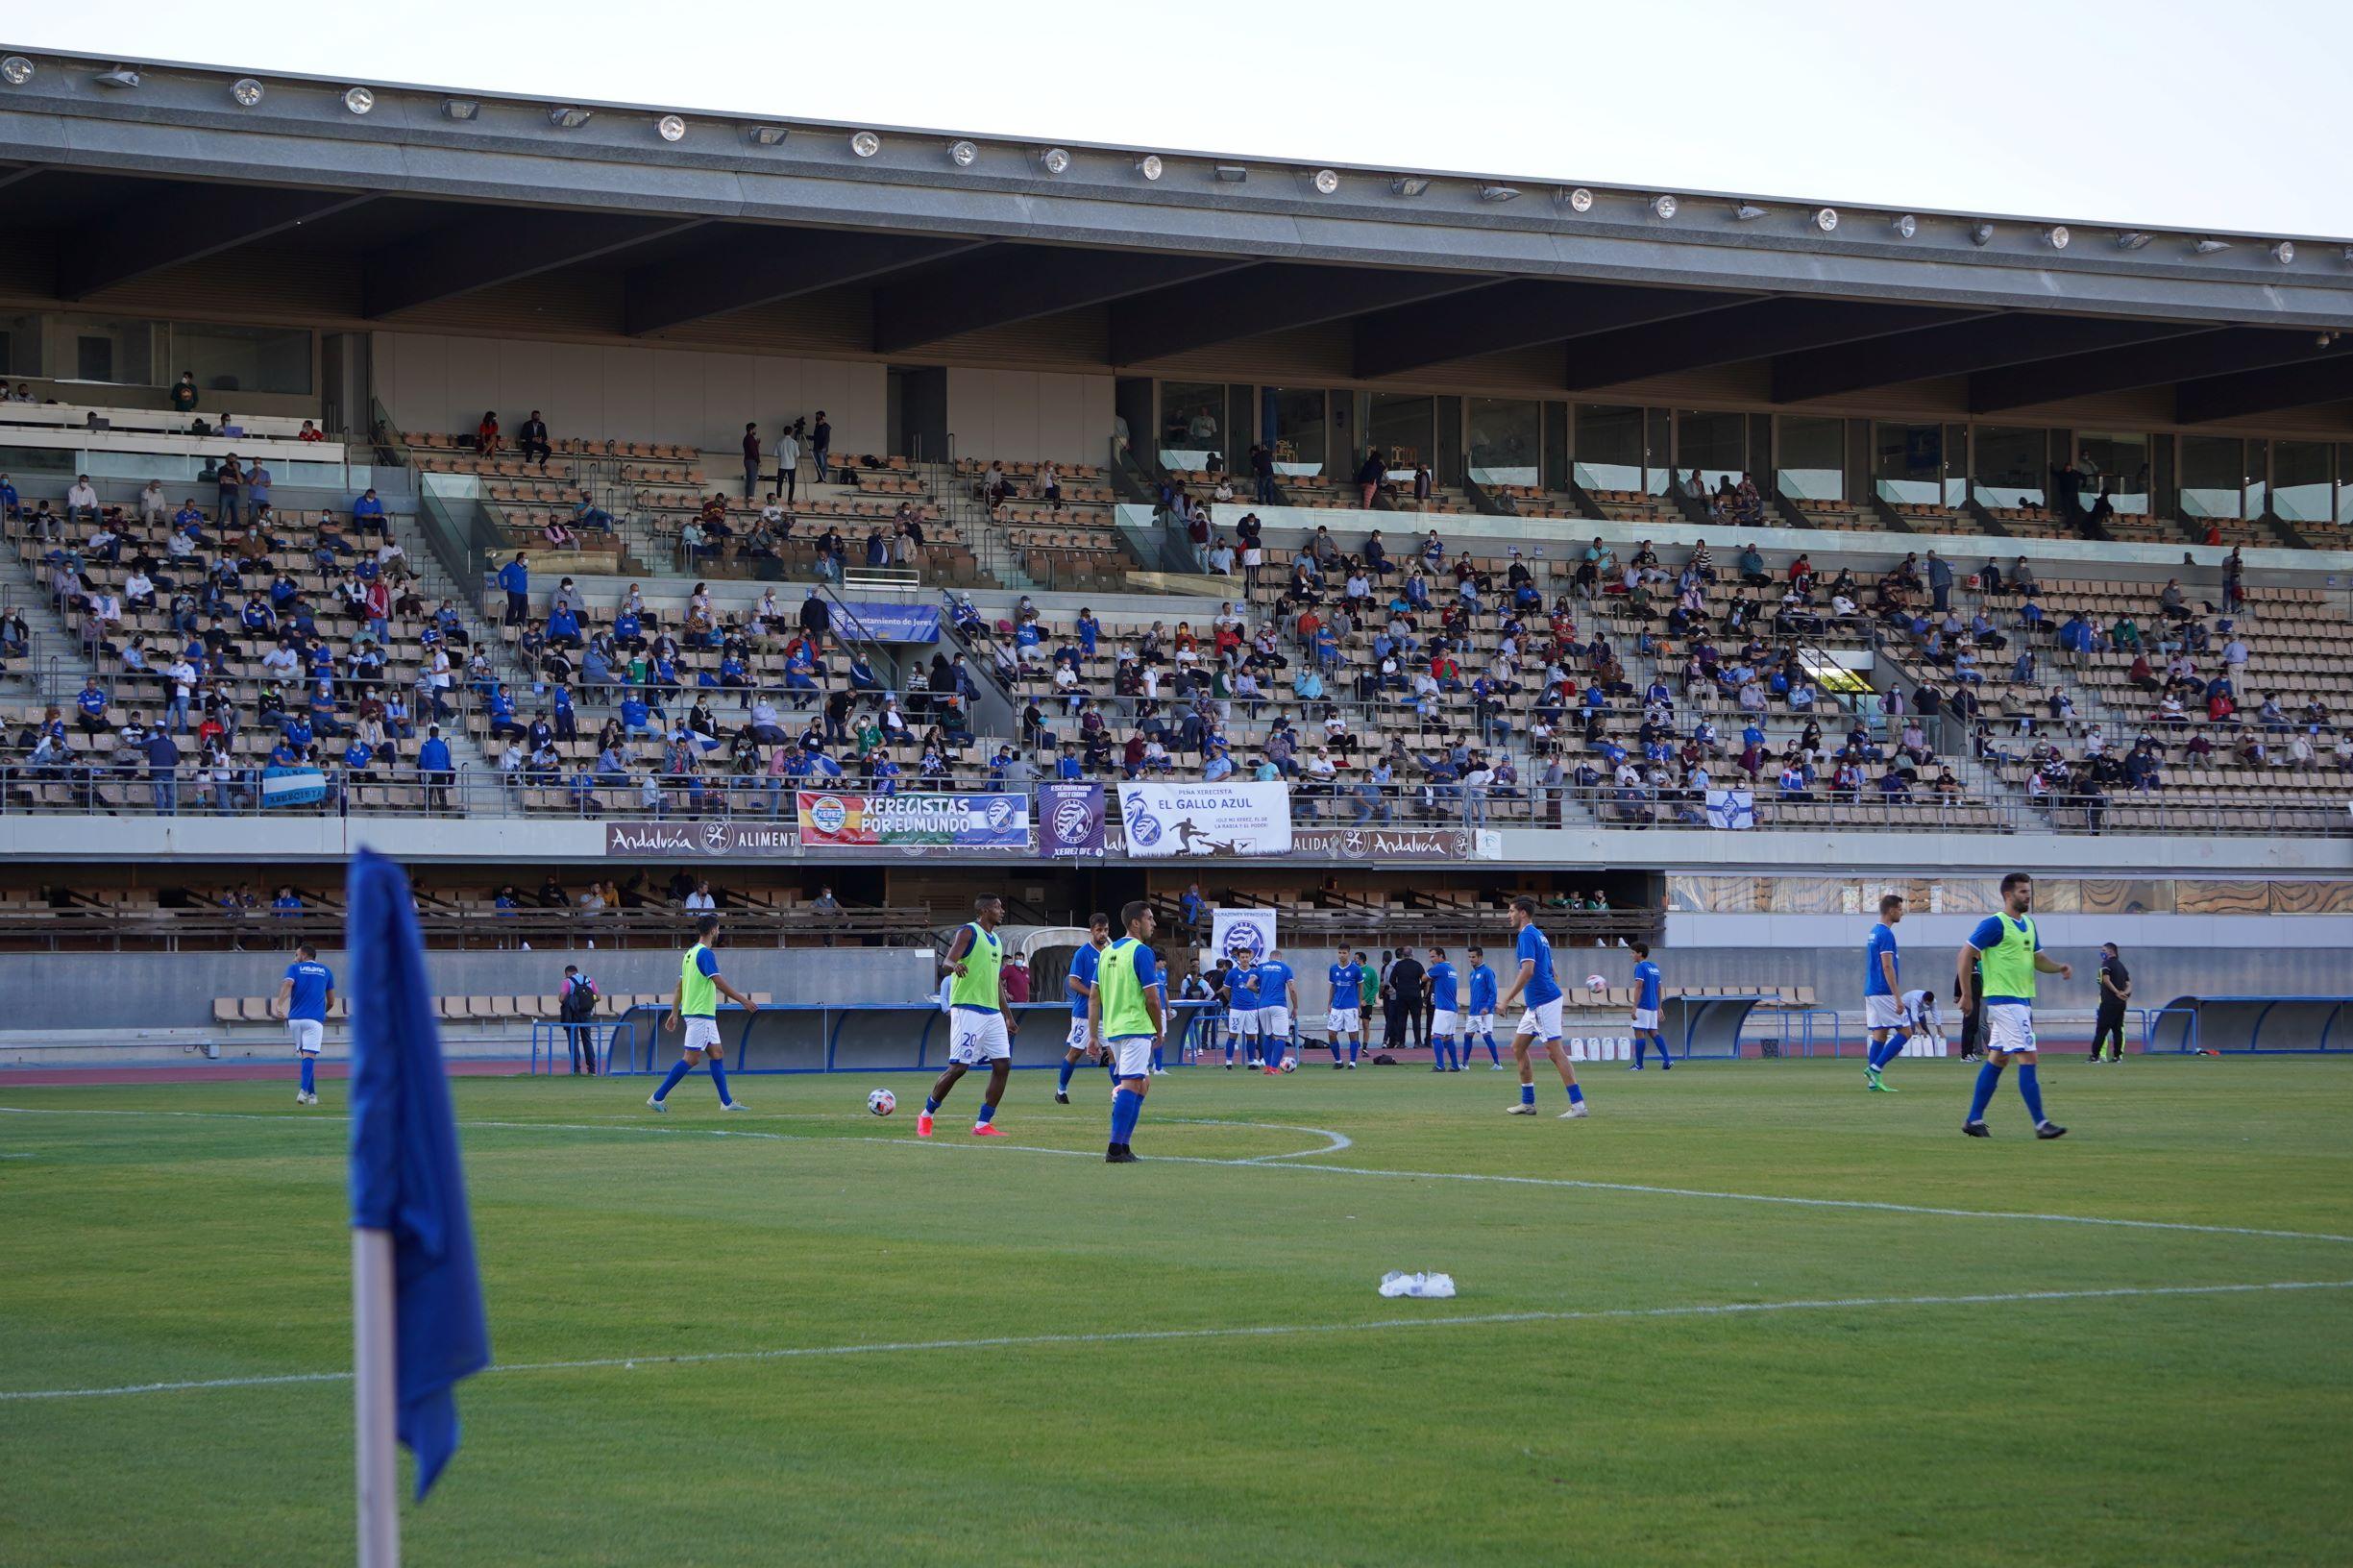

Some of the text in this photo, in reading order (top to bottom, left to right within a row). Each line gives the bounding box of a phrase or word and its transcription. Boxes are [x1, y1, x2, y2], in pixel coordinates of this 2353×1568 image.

[913, 618, 932, 626] Jerez
[1159, 797, 1253, 810] EL GALLO AZUL
[817, 810, 842, 819] XEREZ
[861, 818, 969, 833] POR EL MUNDO
[612, 827, 696, 850] Andalucía
[1293, 837, 1338, 850] ALIDA
[1374, 833, 1446, 855] Andalucía
[1054, 847, 1078, 856] XEREZ
[1074, 1024, 1085, 1037] 15
[2022, 1020, 2030, 1034] 5
[962, 1032, 977, 1046] 20
